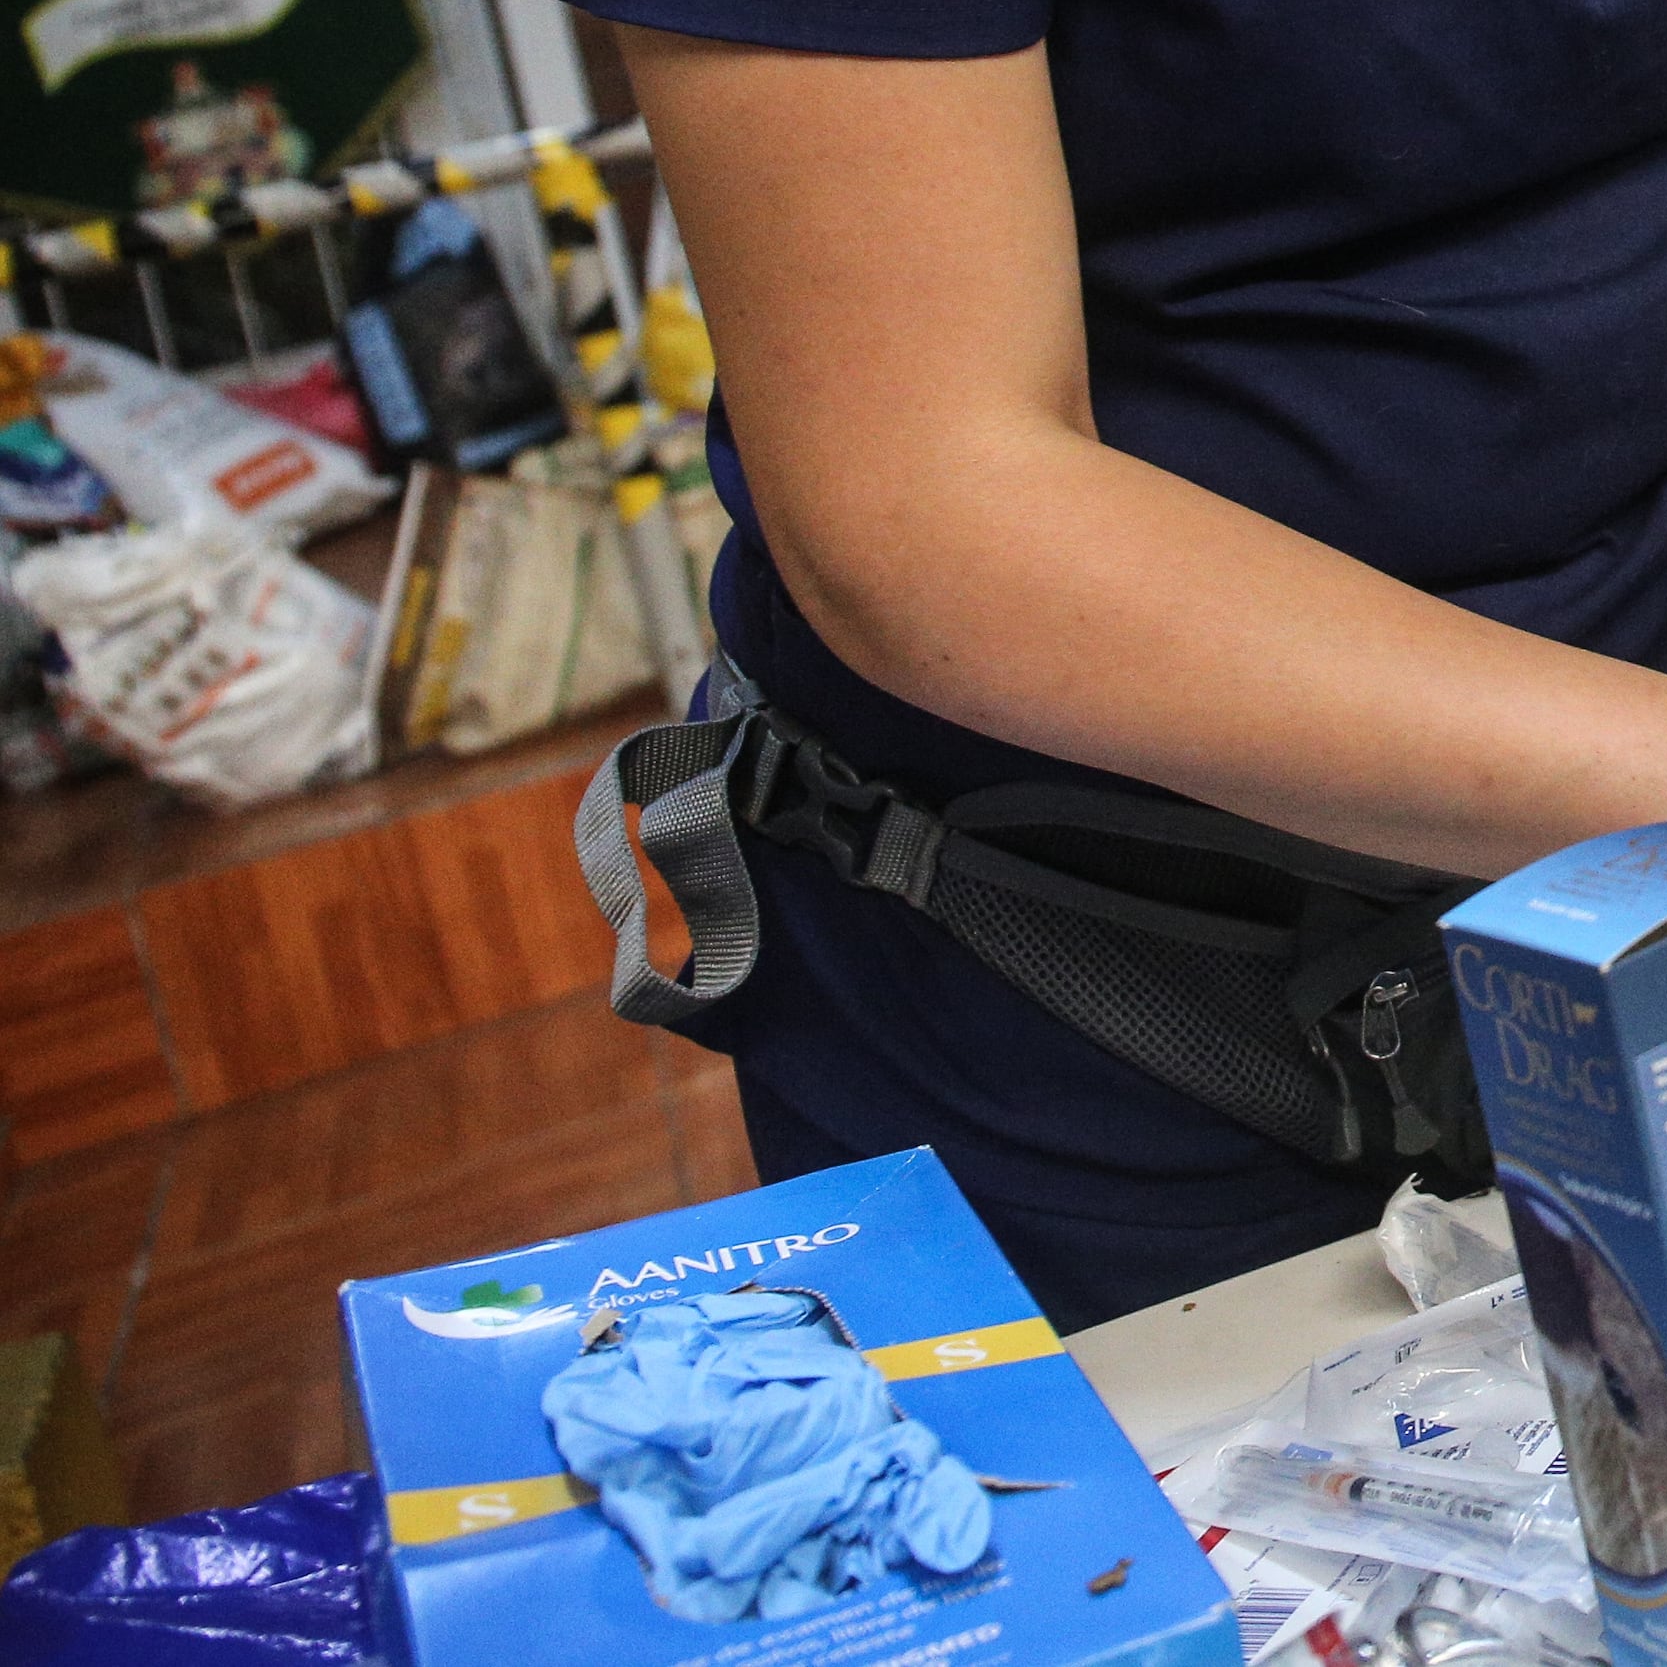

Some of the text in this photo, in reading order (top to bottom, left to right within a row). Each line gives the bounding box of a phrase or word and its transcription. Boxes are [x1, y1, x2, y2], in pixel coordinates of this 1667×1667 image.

[588, 1222, 861, 1298] AANITRO
[588, 1286, 681, 1311] Gloves
[934, 1338, 987, 1369] S
[457, 1492, 518, 1532] S
